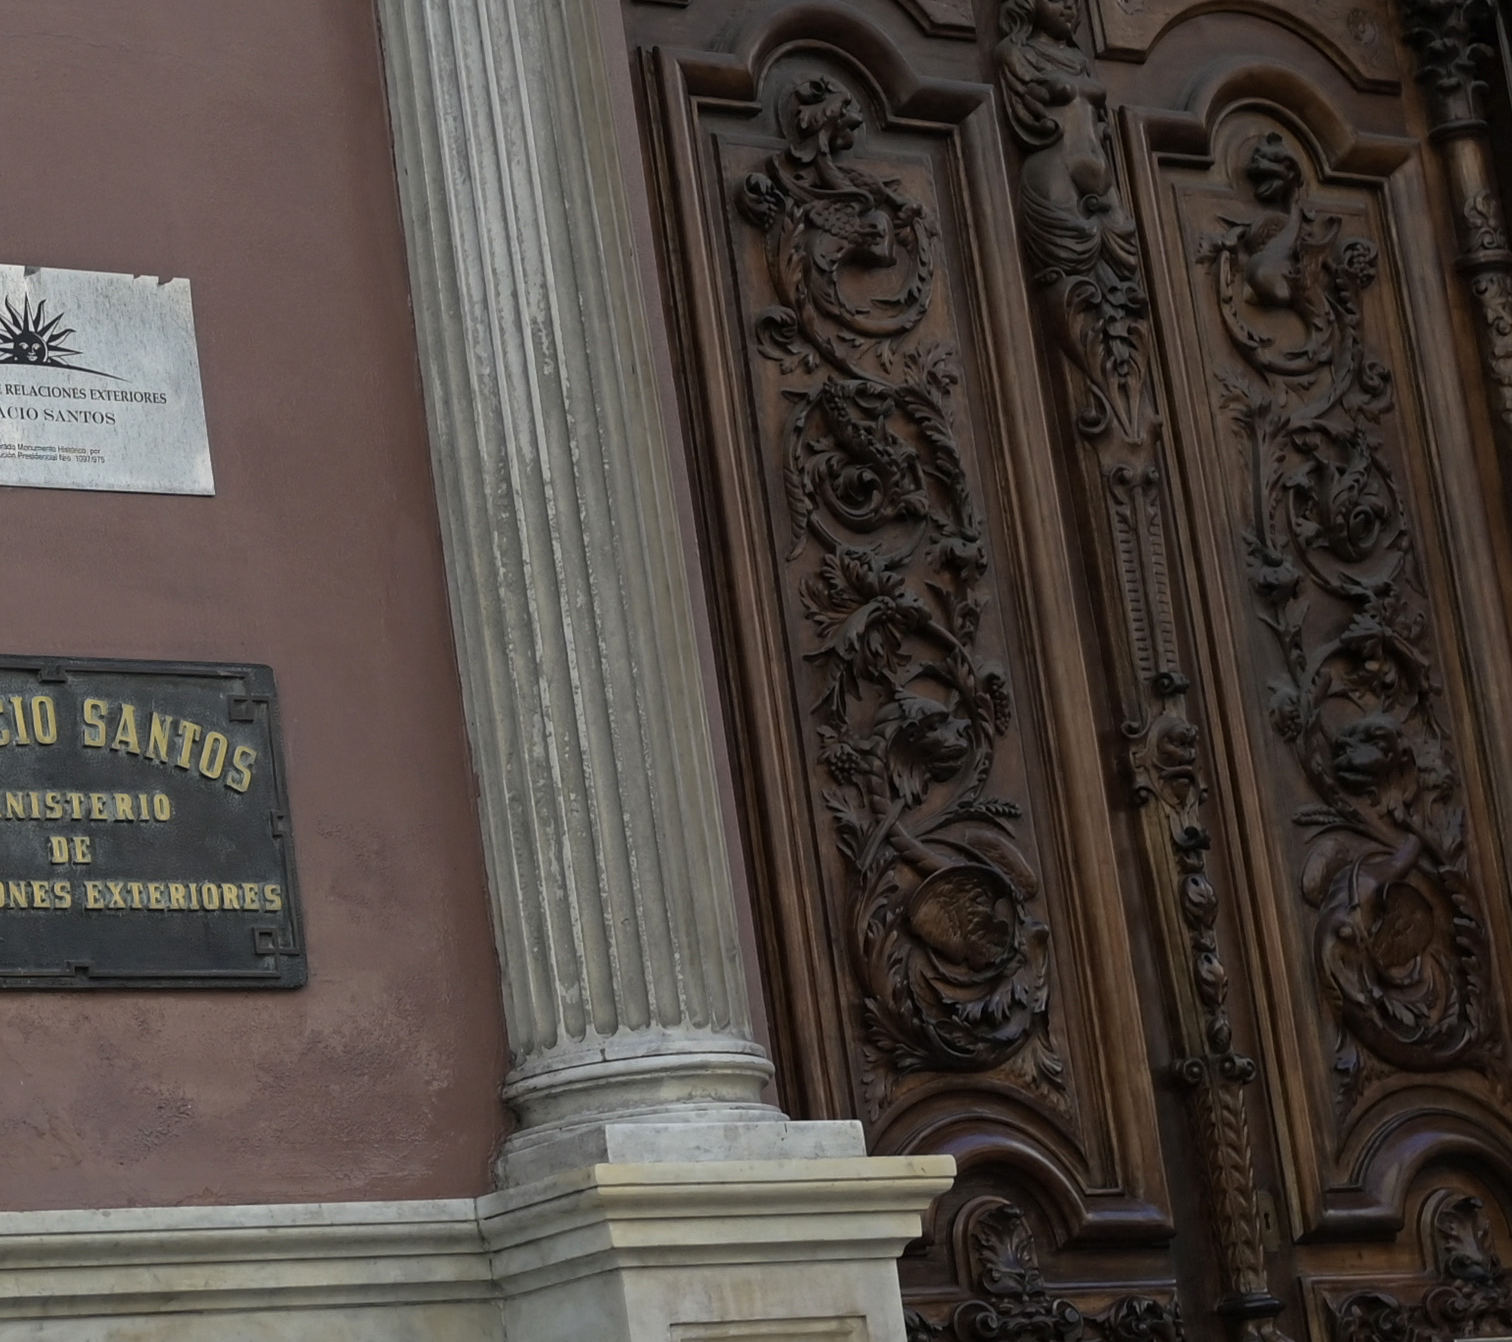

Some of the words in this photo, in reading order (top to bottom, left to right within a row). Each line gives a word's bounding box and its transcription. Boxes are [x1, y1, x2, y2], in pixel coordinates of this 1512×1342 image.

[5, 384, 87, 400] RELACIONES
[90, 389, 168, 404] EXTERIORES
[43, 408, 117, 425] SANTOS
[83, 698, 258, 793] SANTOS
[49, 836, 92, 865] DE
[84, 880, 283, 911] EXTERIORES
